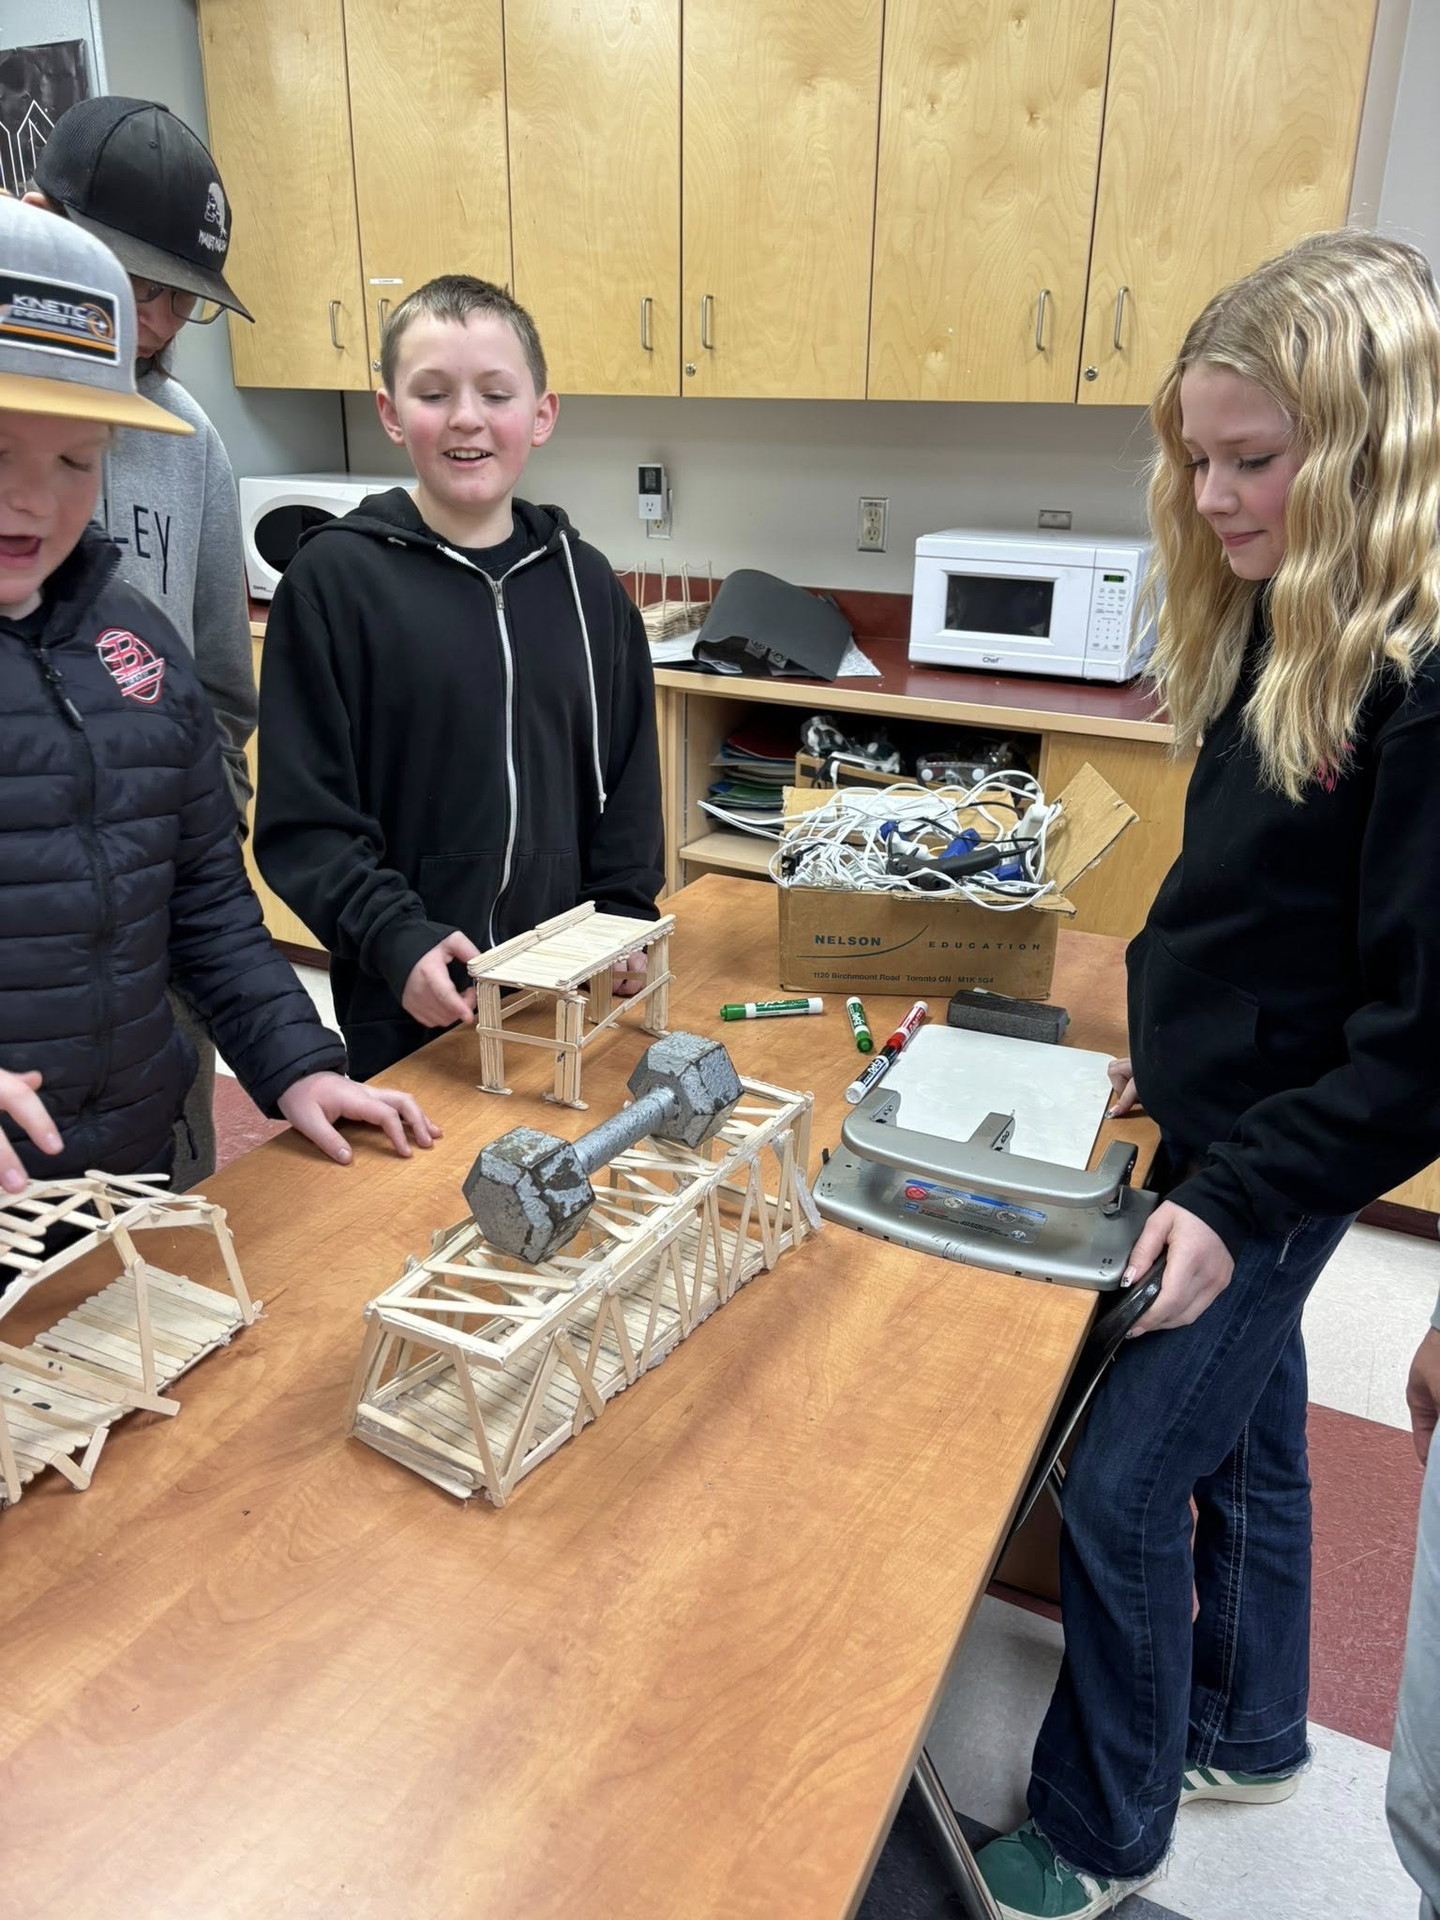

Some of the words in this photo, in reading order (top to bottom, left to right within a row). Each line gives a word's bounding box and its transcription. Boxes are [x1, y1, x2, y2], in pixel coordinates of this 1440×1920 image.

[12, 293, 88, 320] KINETIC
[982, 656, 1000, 664] Chef
[814, 934, 881, 946] NELSON
[928, 941, 1040, 950] EDUCATION
[831, 972, 878, 981] Birchmount
[879, 973, 901, 981] Road
[905, 974, 937, 982] Toronto
[938, 975, 952, 983] ON
